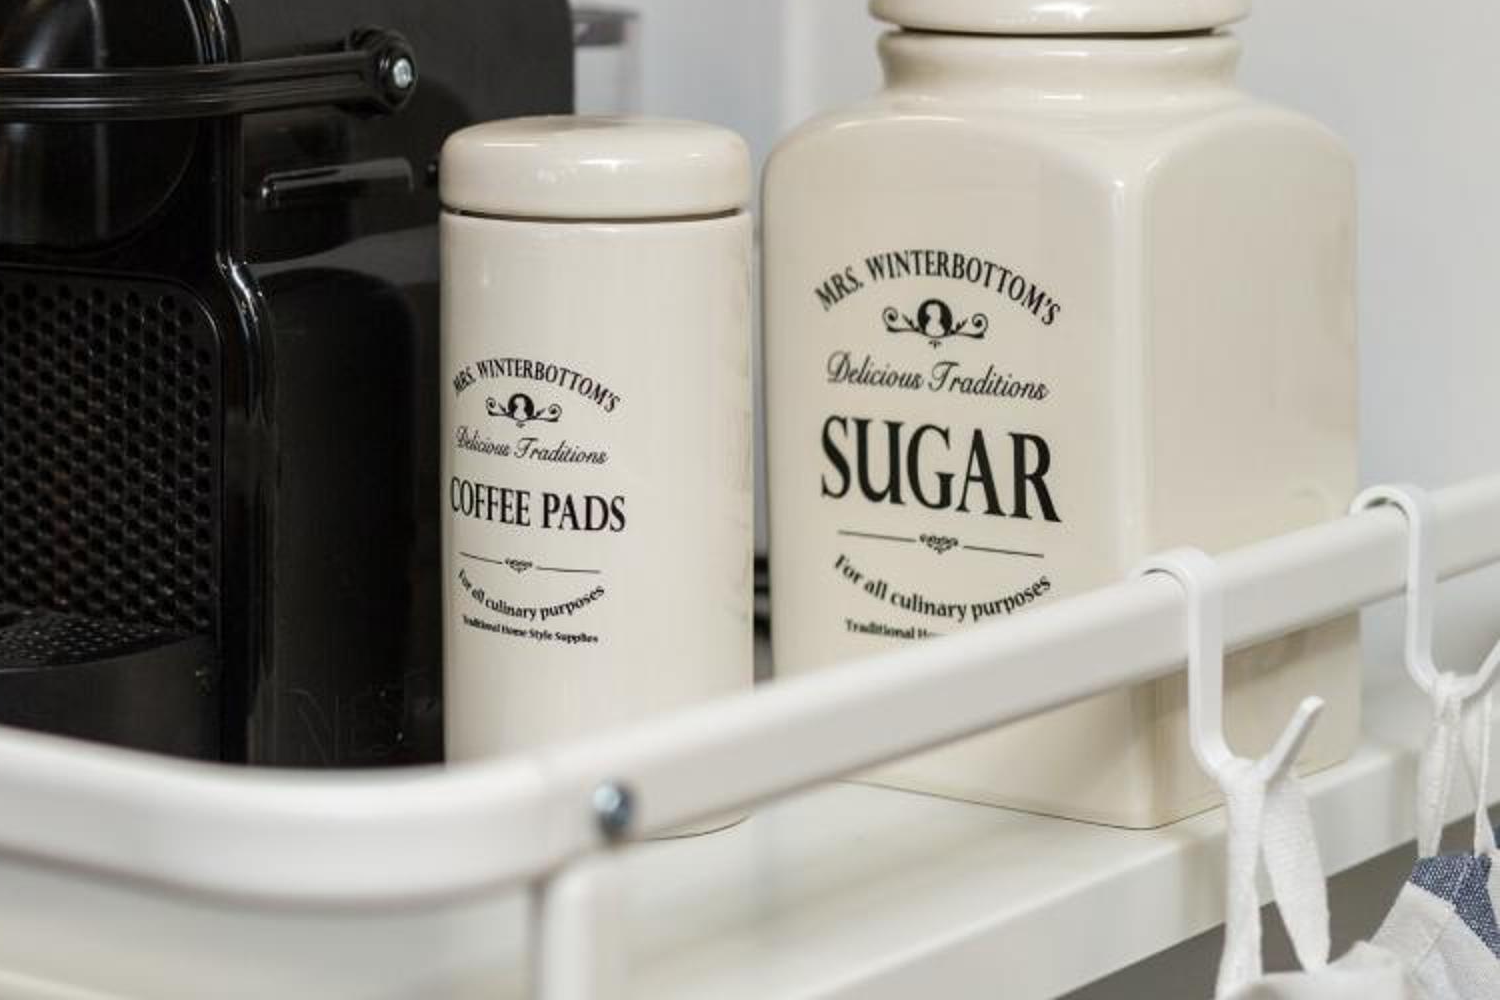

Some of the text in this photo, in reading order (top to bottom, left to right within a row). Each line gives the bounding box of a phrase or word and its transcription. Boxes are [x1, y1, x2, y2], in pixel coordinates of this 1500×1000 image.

[814, 249, 1062, 327] MRS. WINTERBOTTOM'S
[476, 358, 621, 413] WINTERBOTTOM'S
[826, 350, 1049, 401] Delicious Traditions
[455, 425, 609, 464] Delicious Traditions
[820, 415, 1062, 523] SUGAR
[451, 476, 627, 533] COFFEE PADS
[458, 568, 472, 591] For
[485, 599, 536, 621] culinary
[540, 585, 605, 620] purposes
[834, 553, 1052, 623] For all culinary purposes
[529, 629, 552, 642] Style
[555, 631, 599, 644] Supplies
[844, 619, 915, 639] Traditional
